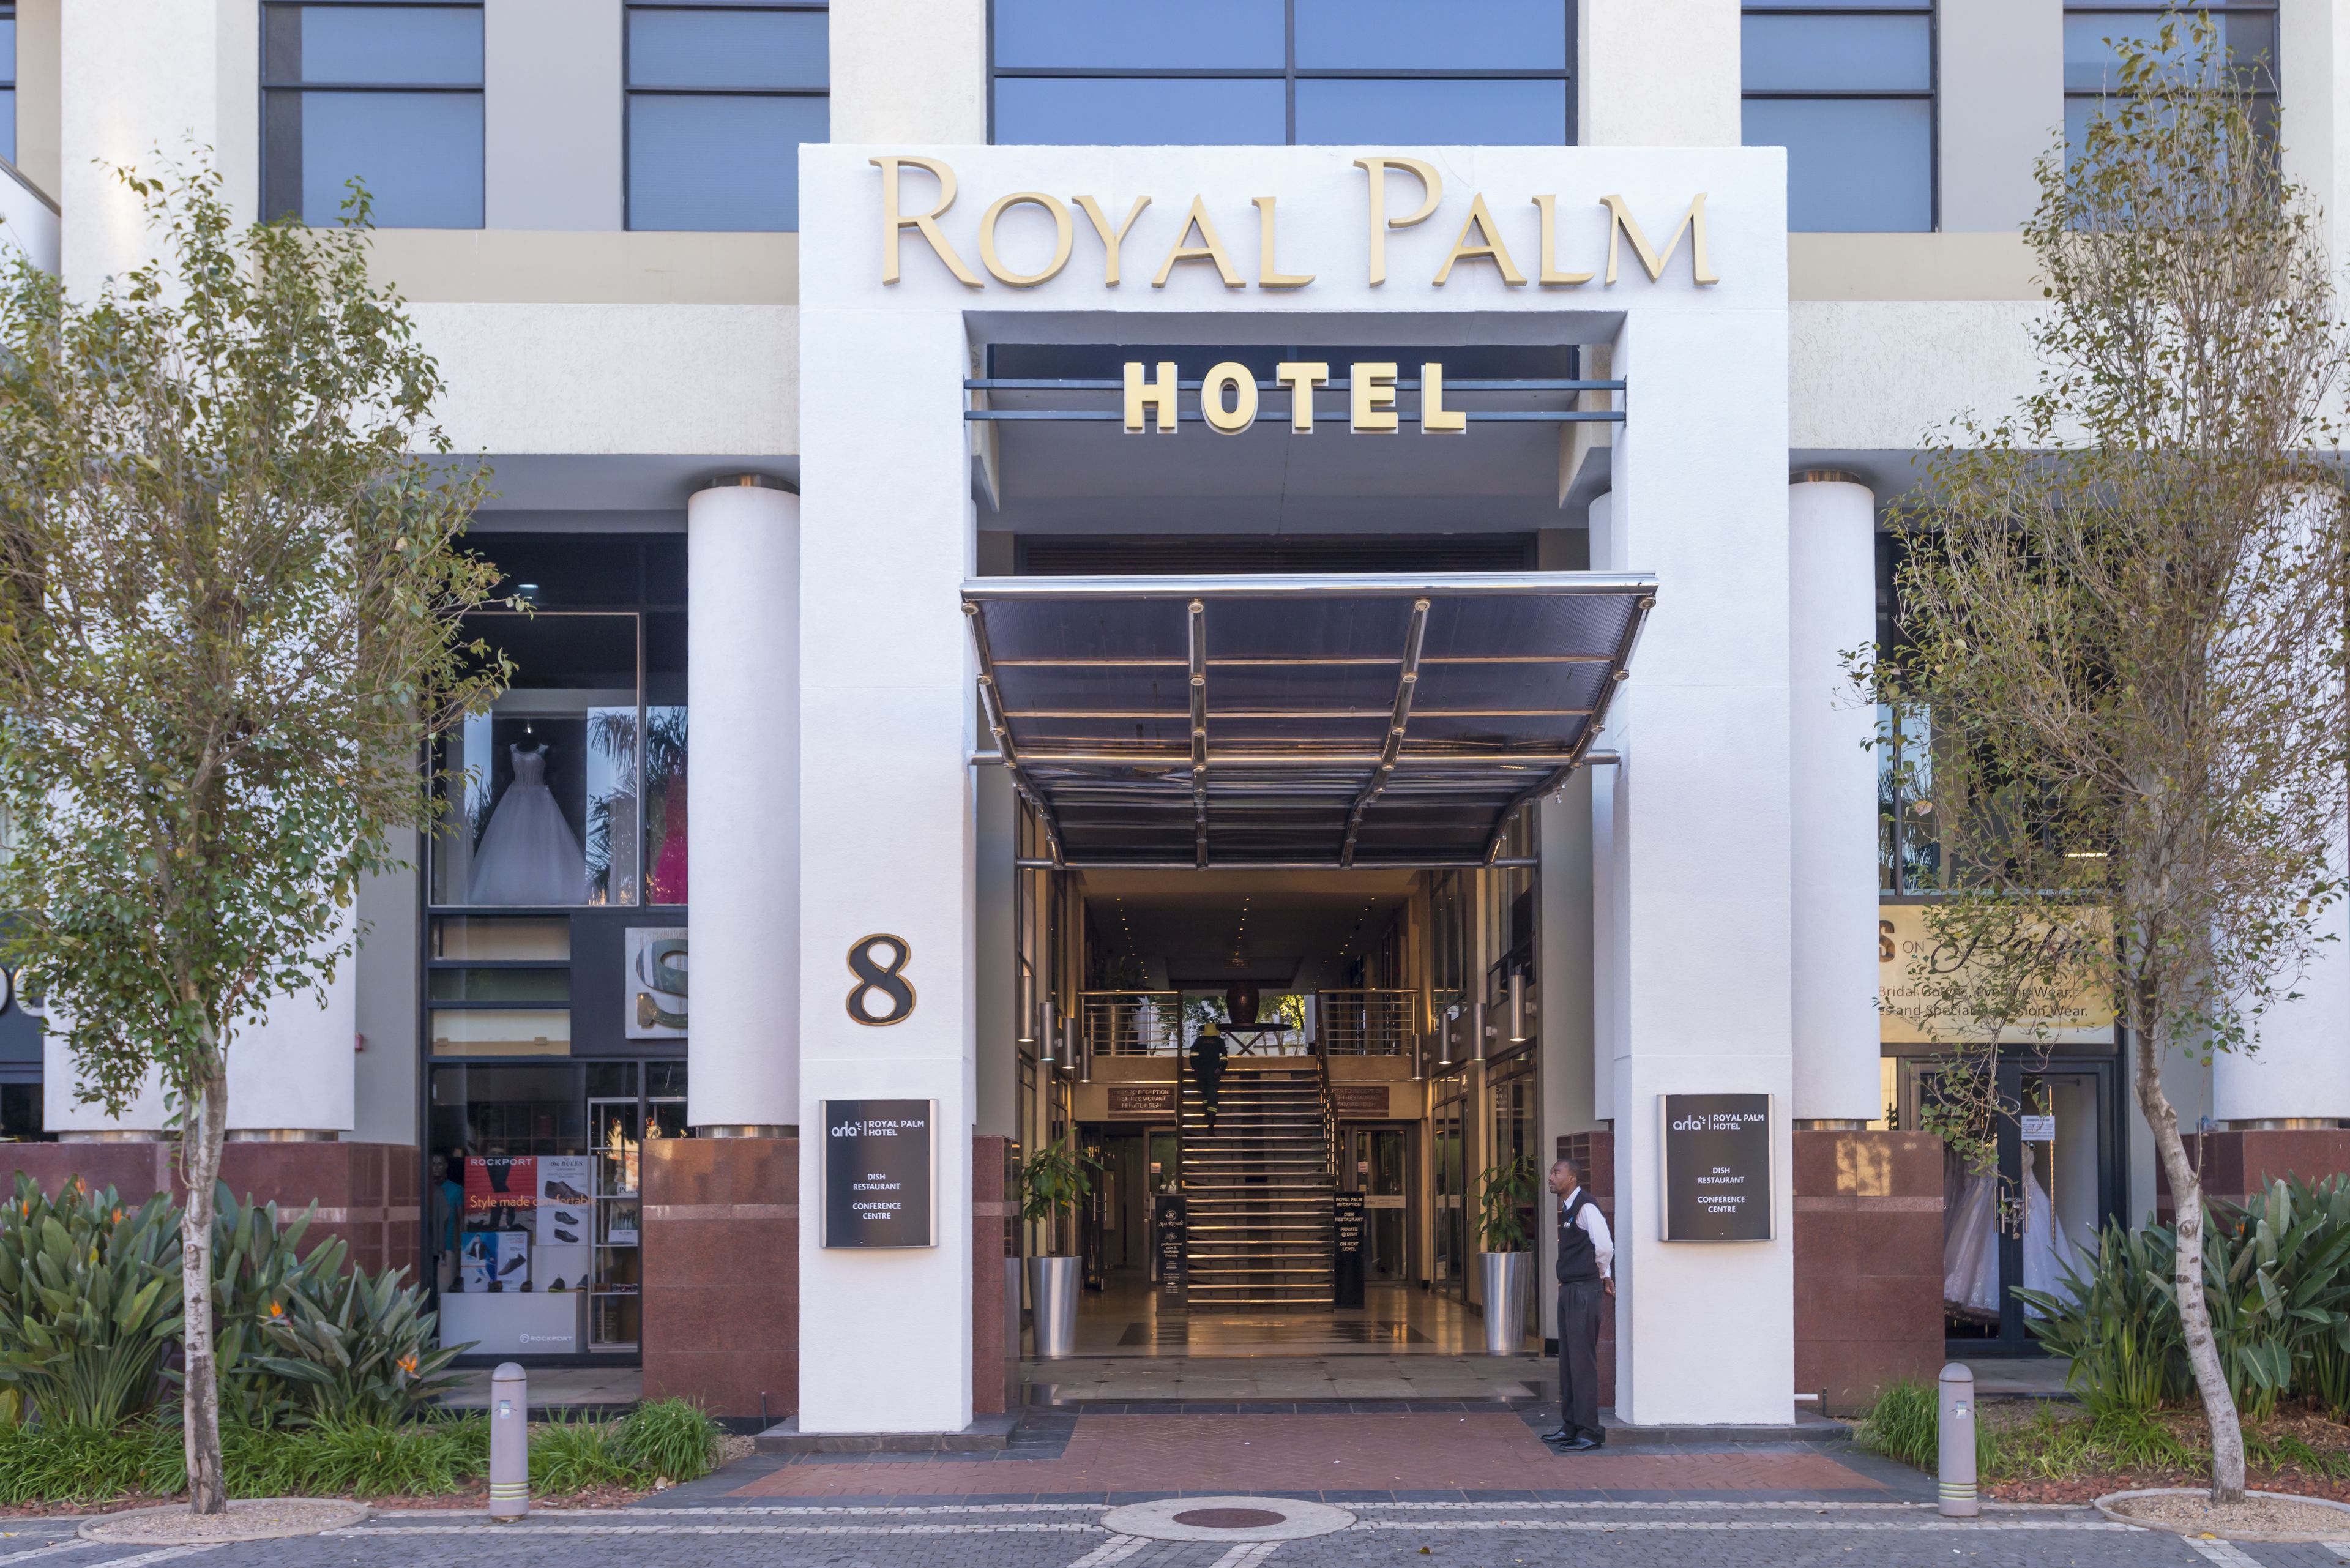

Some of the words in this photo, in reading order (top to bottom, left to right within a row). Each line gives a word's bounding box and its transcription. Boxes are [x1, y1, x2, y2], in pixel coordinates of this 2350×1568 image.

[1124, 362, 1466, 435] HOTEL
[1902, 940, 1925, 954] ON
[846, 933, 917, 1026] 8
[1879, 985, 1916, 997] Bridal
[1897, 1004, 1920, 1016] and
[2051, 1006, 2088, 1017] Wear.
[471, 1158, 532, 1167] ROCKPORT
[469, 1195, 497, 1210] Style
[499, 1195, 529, 1208] made
